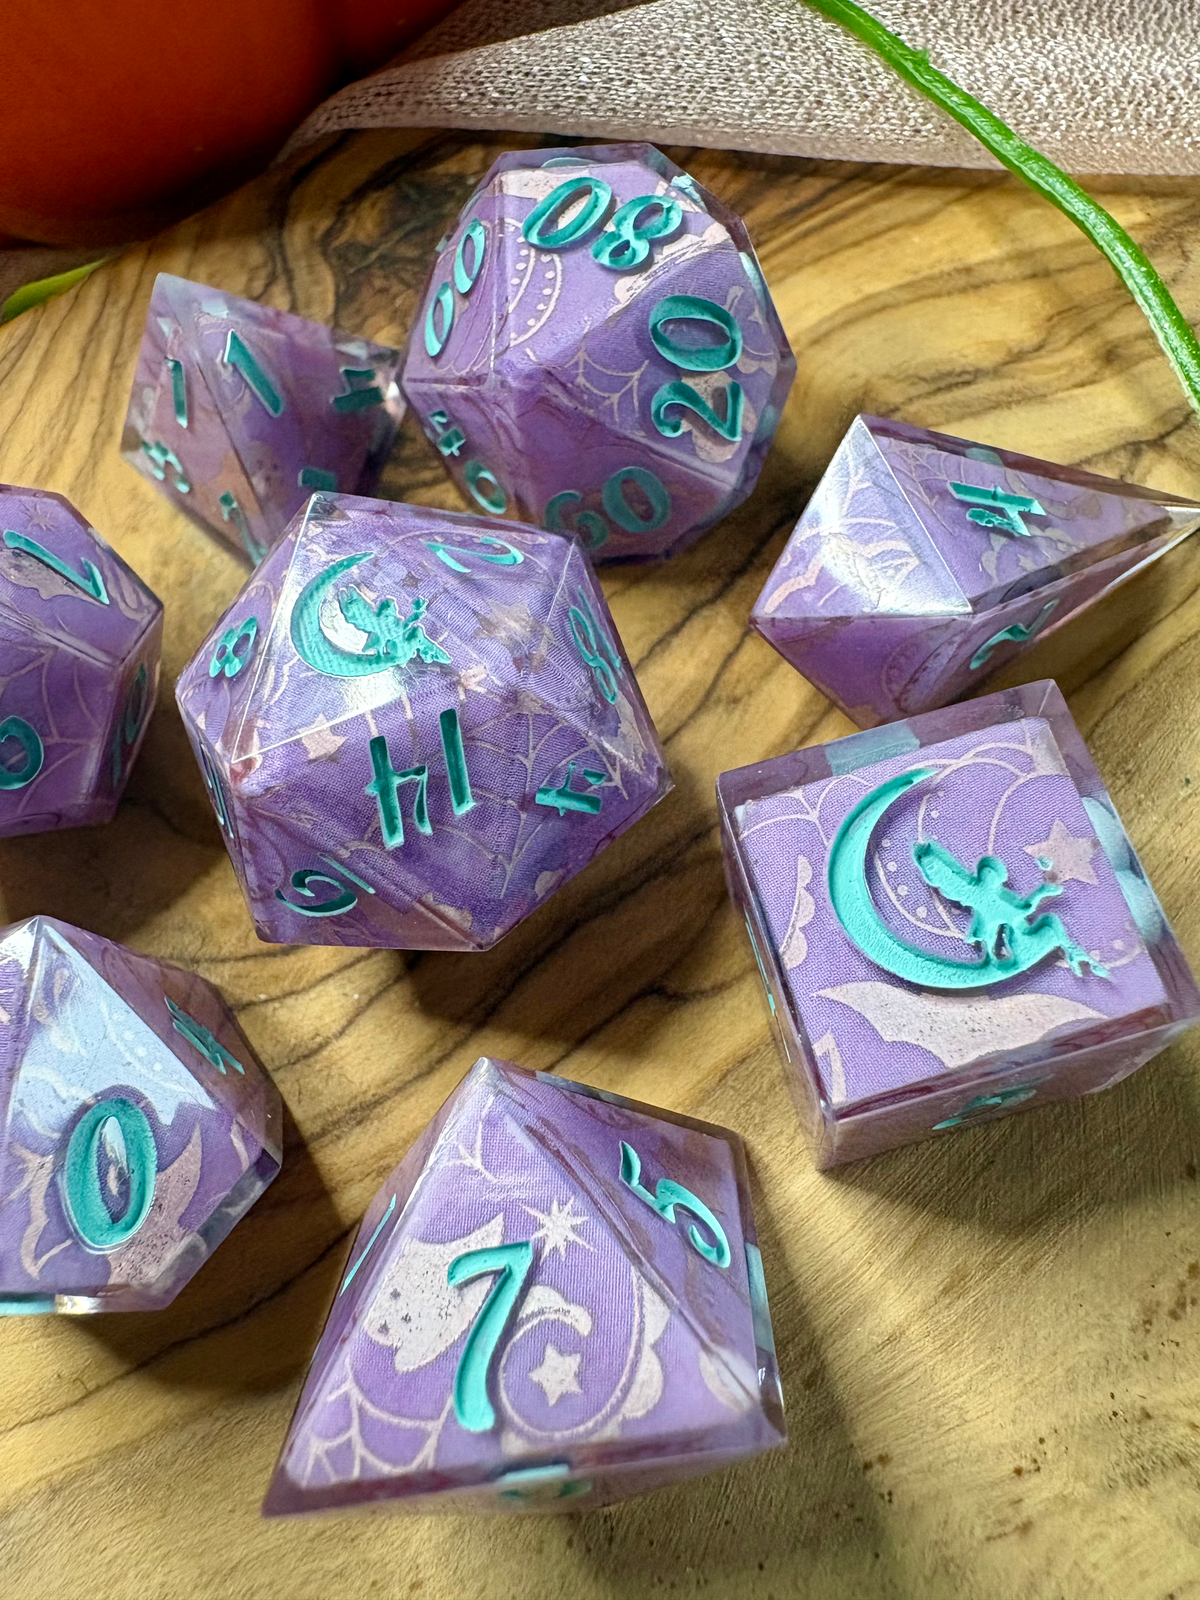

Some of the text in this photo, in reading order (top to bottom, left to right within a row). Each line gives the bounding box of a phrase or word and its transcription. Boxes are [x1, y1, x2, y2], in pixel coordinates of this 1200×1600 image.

[425, 218, 486, 357] 00
[649, 295, 744, 442] 20
[209, 616, 258, 678] 8
[365, 708, 476, 850] 14
[65, 1098, 157, 1255] 0
[619, 1140, 731, 1269] 5
[447, 1241, 533, 1433] 7
